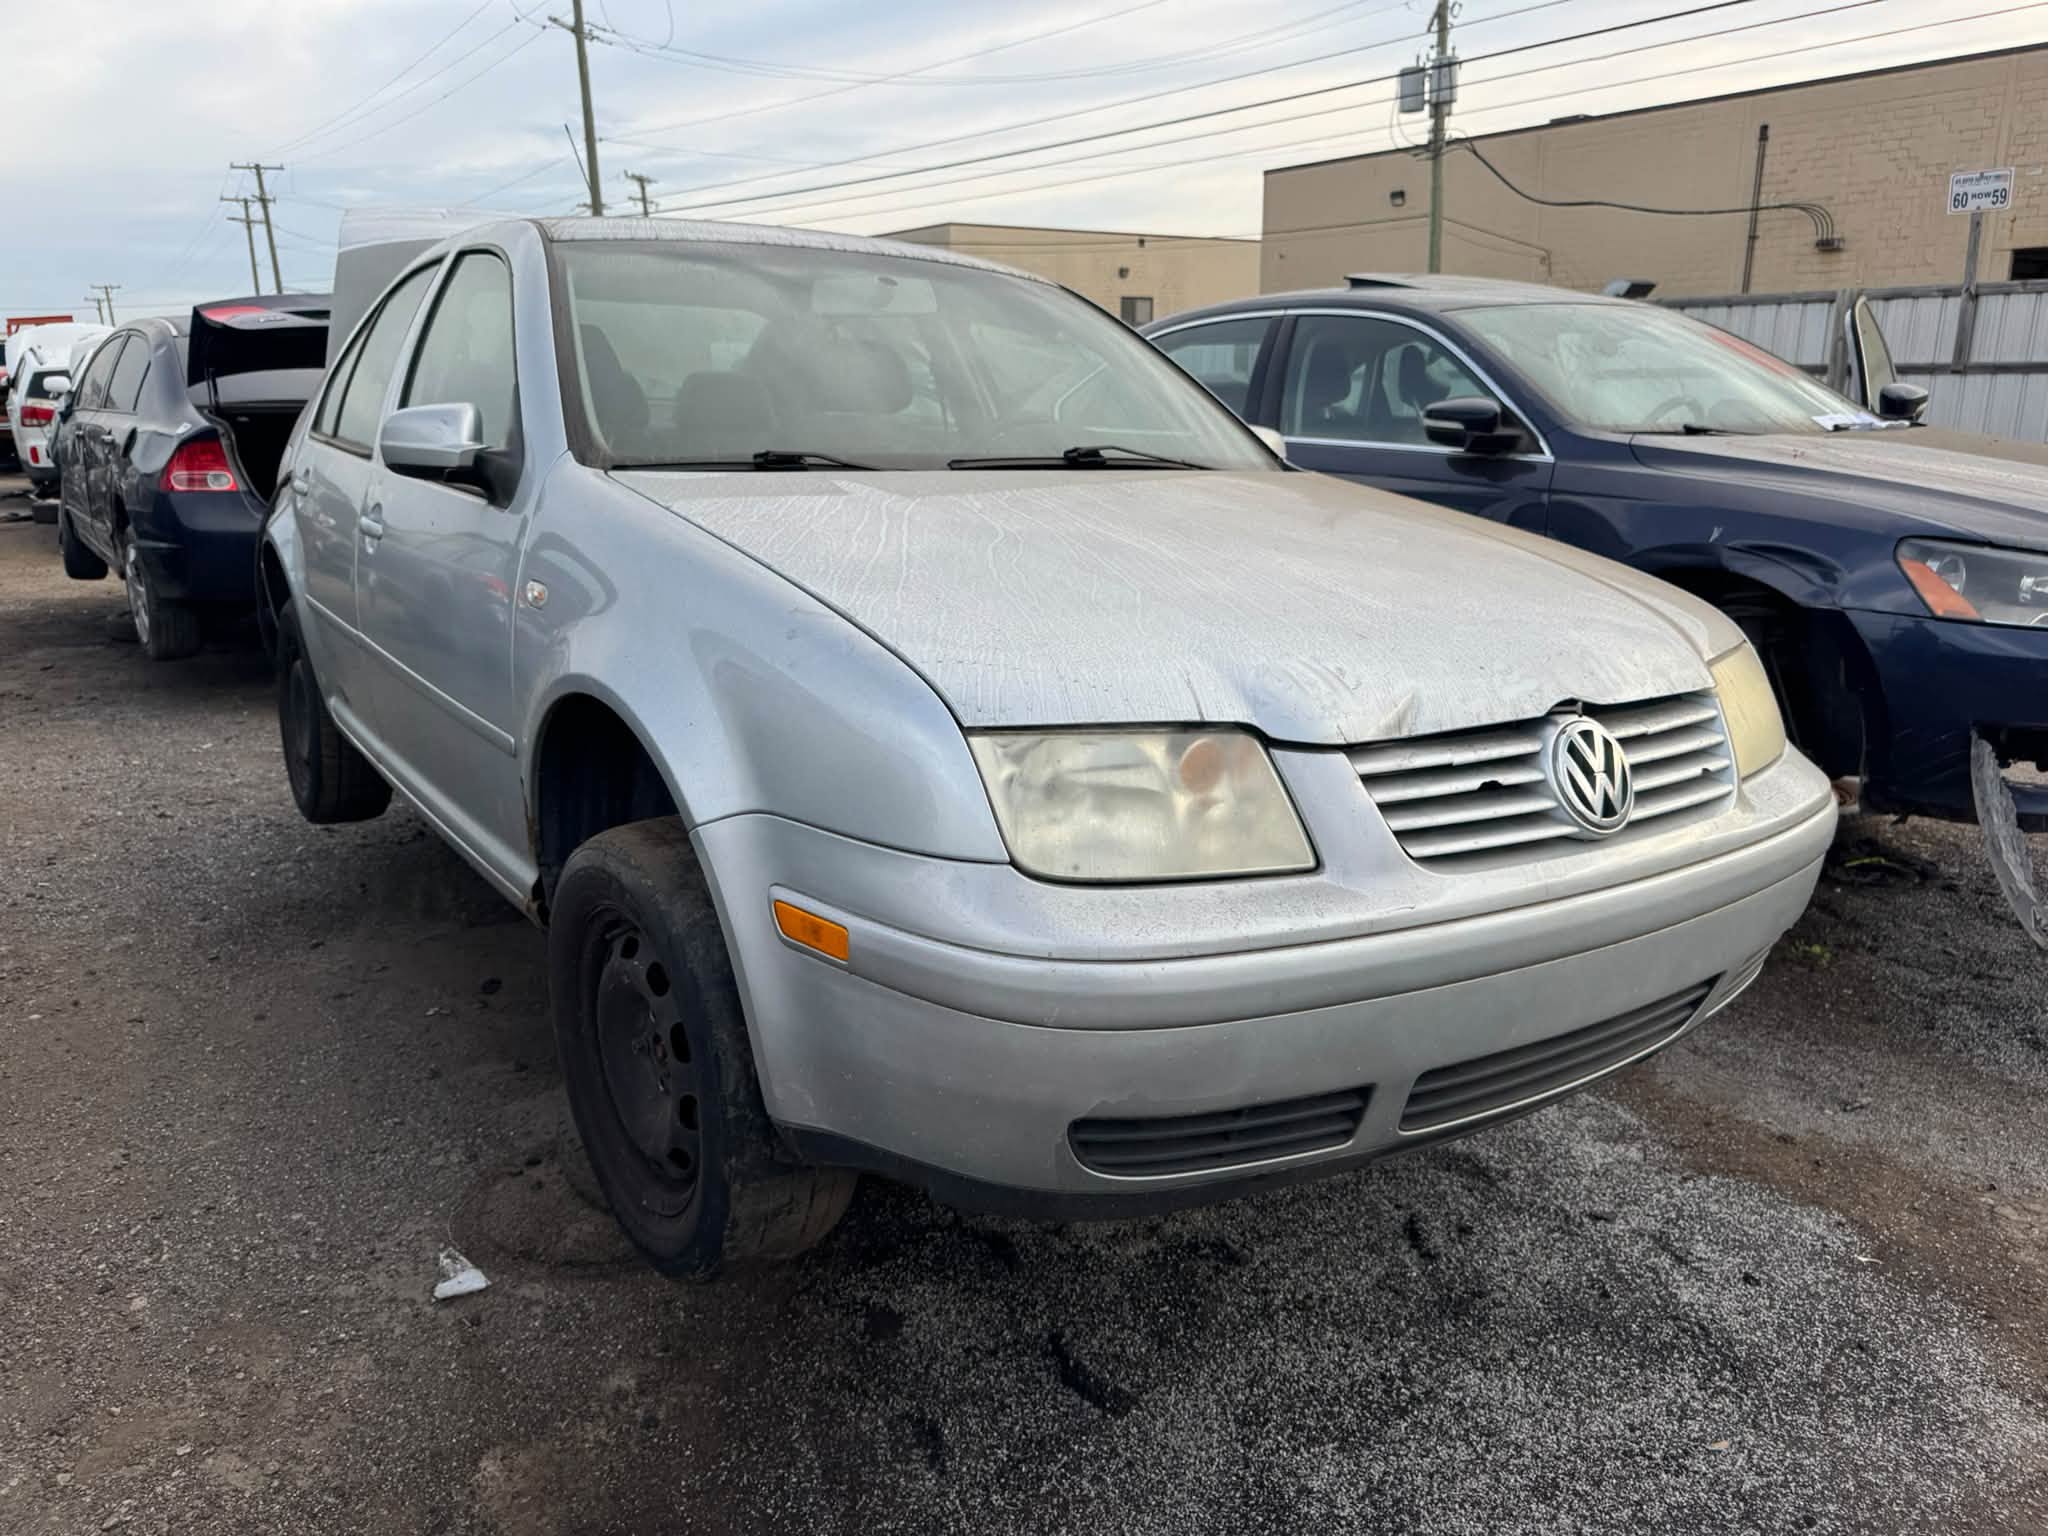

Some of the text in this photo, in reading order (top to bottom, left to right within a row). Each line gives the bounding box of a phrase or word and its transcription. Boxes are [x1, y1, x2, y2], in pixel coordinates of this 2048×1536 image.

[1953, 187, 2007, 208] 60 ROW 59
[1559, 727, 1629, 822] VW
